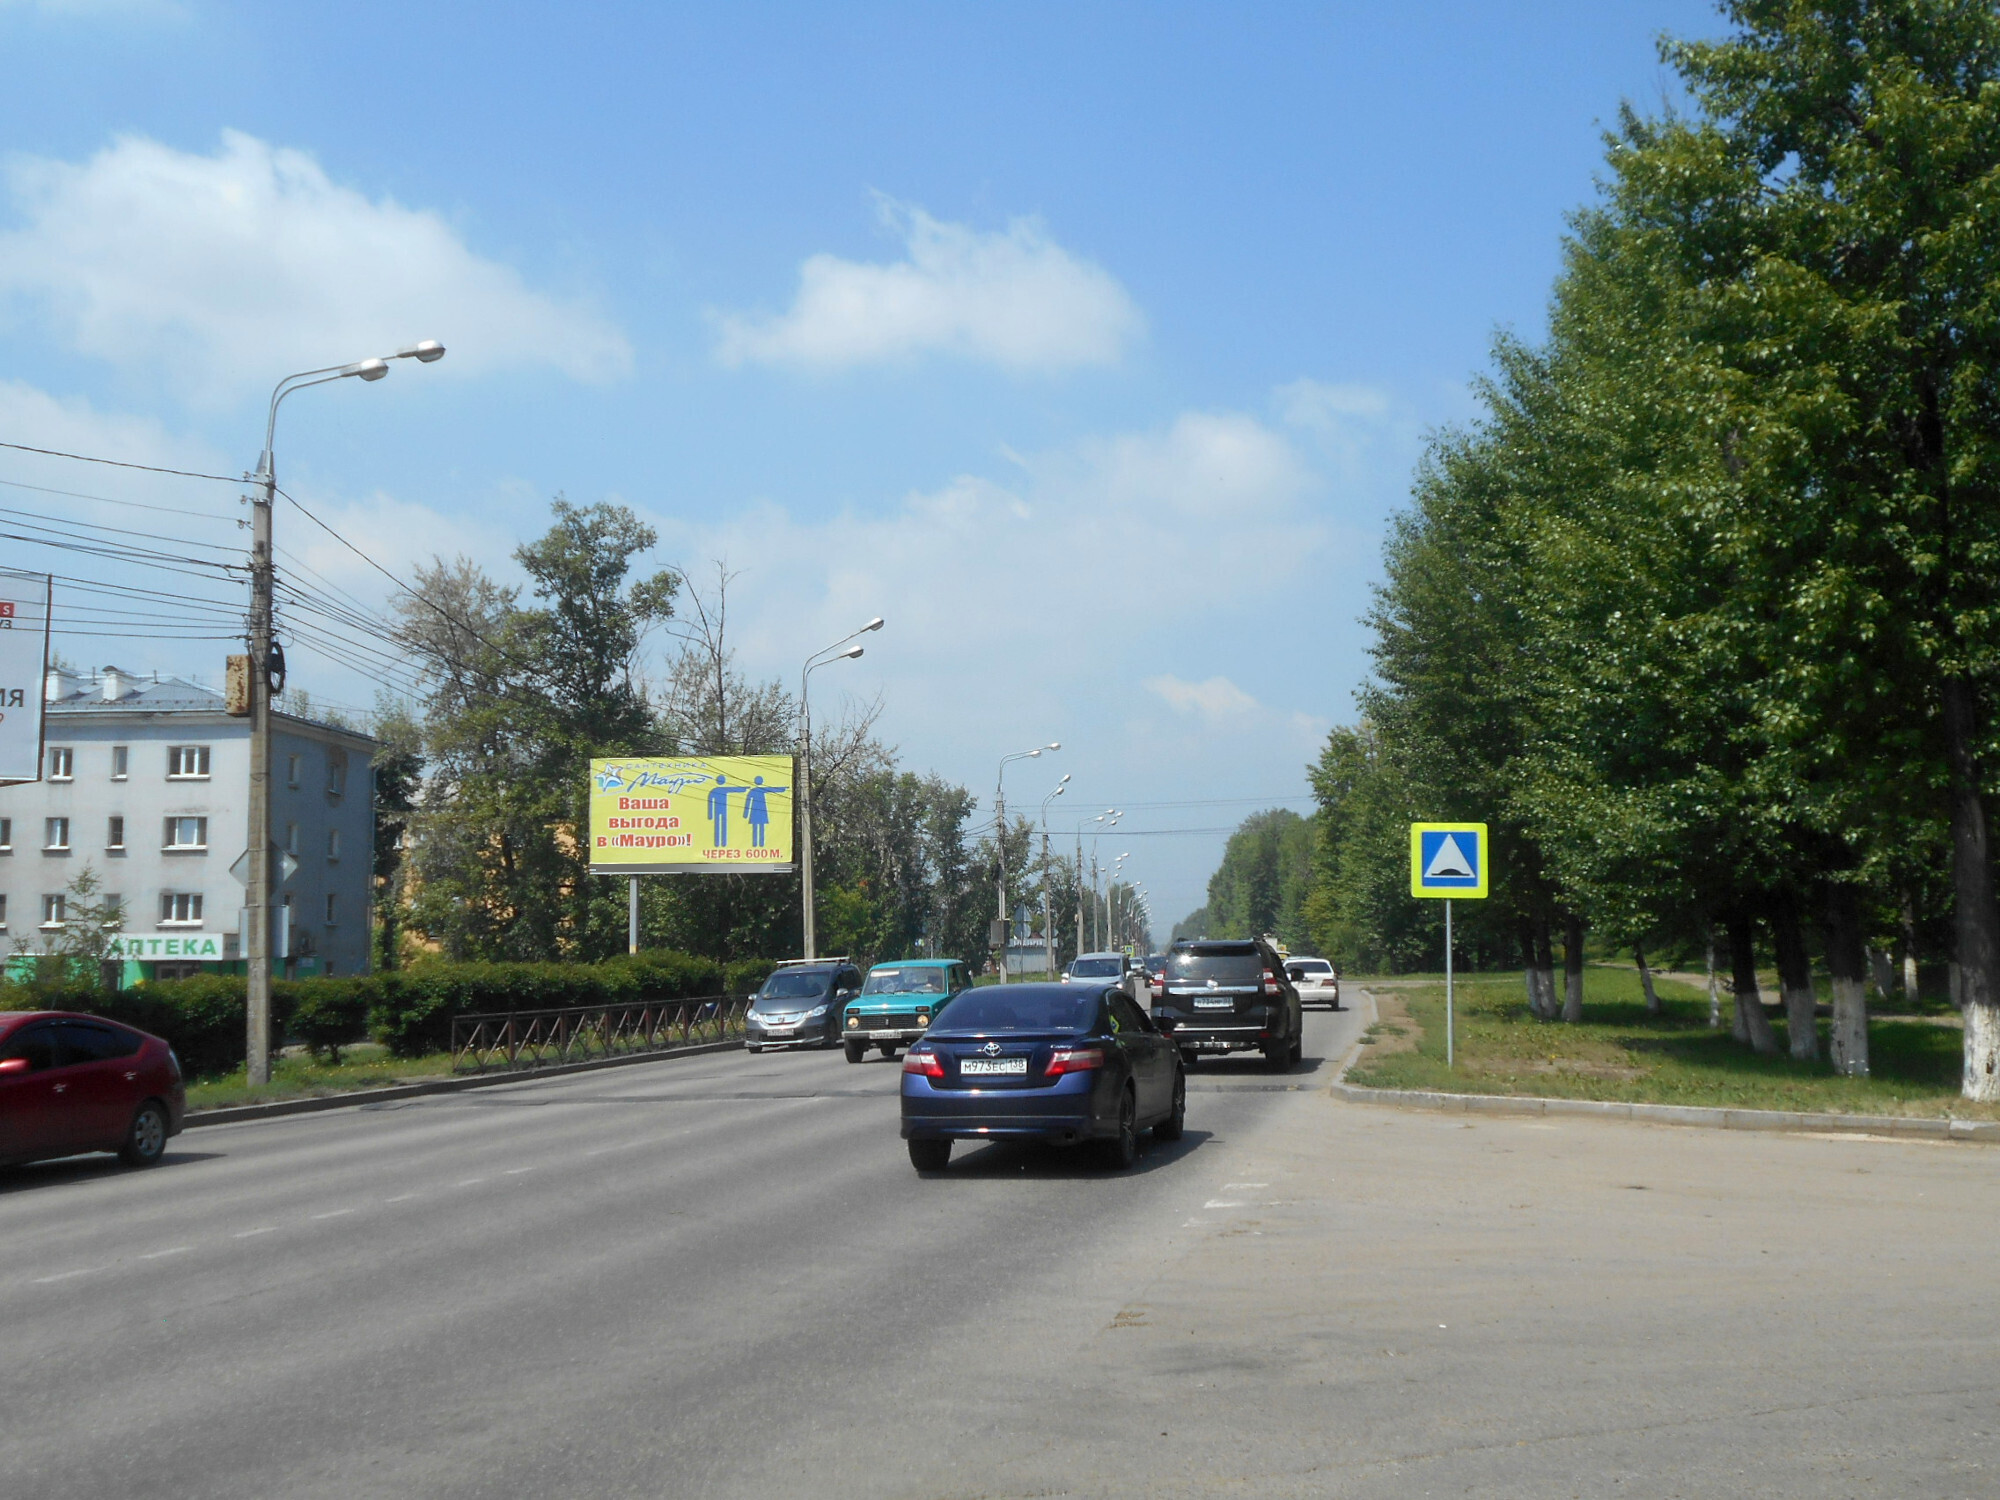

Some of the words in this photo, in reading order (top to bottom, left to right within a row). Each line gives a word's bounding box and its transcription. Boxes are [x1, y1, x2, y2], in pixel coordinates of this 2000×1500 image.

[626, 771, 714, 794] Мауро
[619, 797, 670, 810] Ваша
[608, 817, 680, 830] выгода
[597, 836, 608, 848] в
[612, 833, 692, 848] «Мауро»!
[702, 849, 741, 859] ЧЕРЕЗ
[110, 938, 217, 956] АПТЕКА
[964, 1060, 1006, 1072] М973ЕС
[1008, 1059, 1025, 1069] 138
